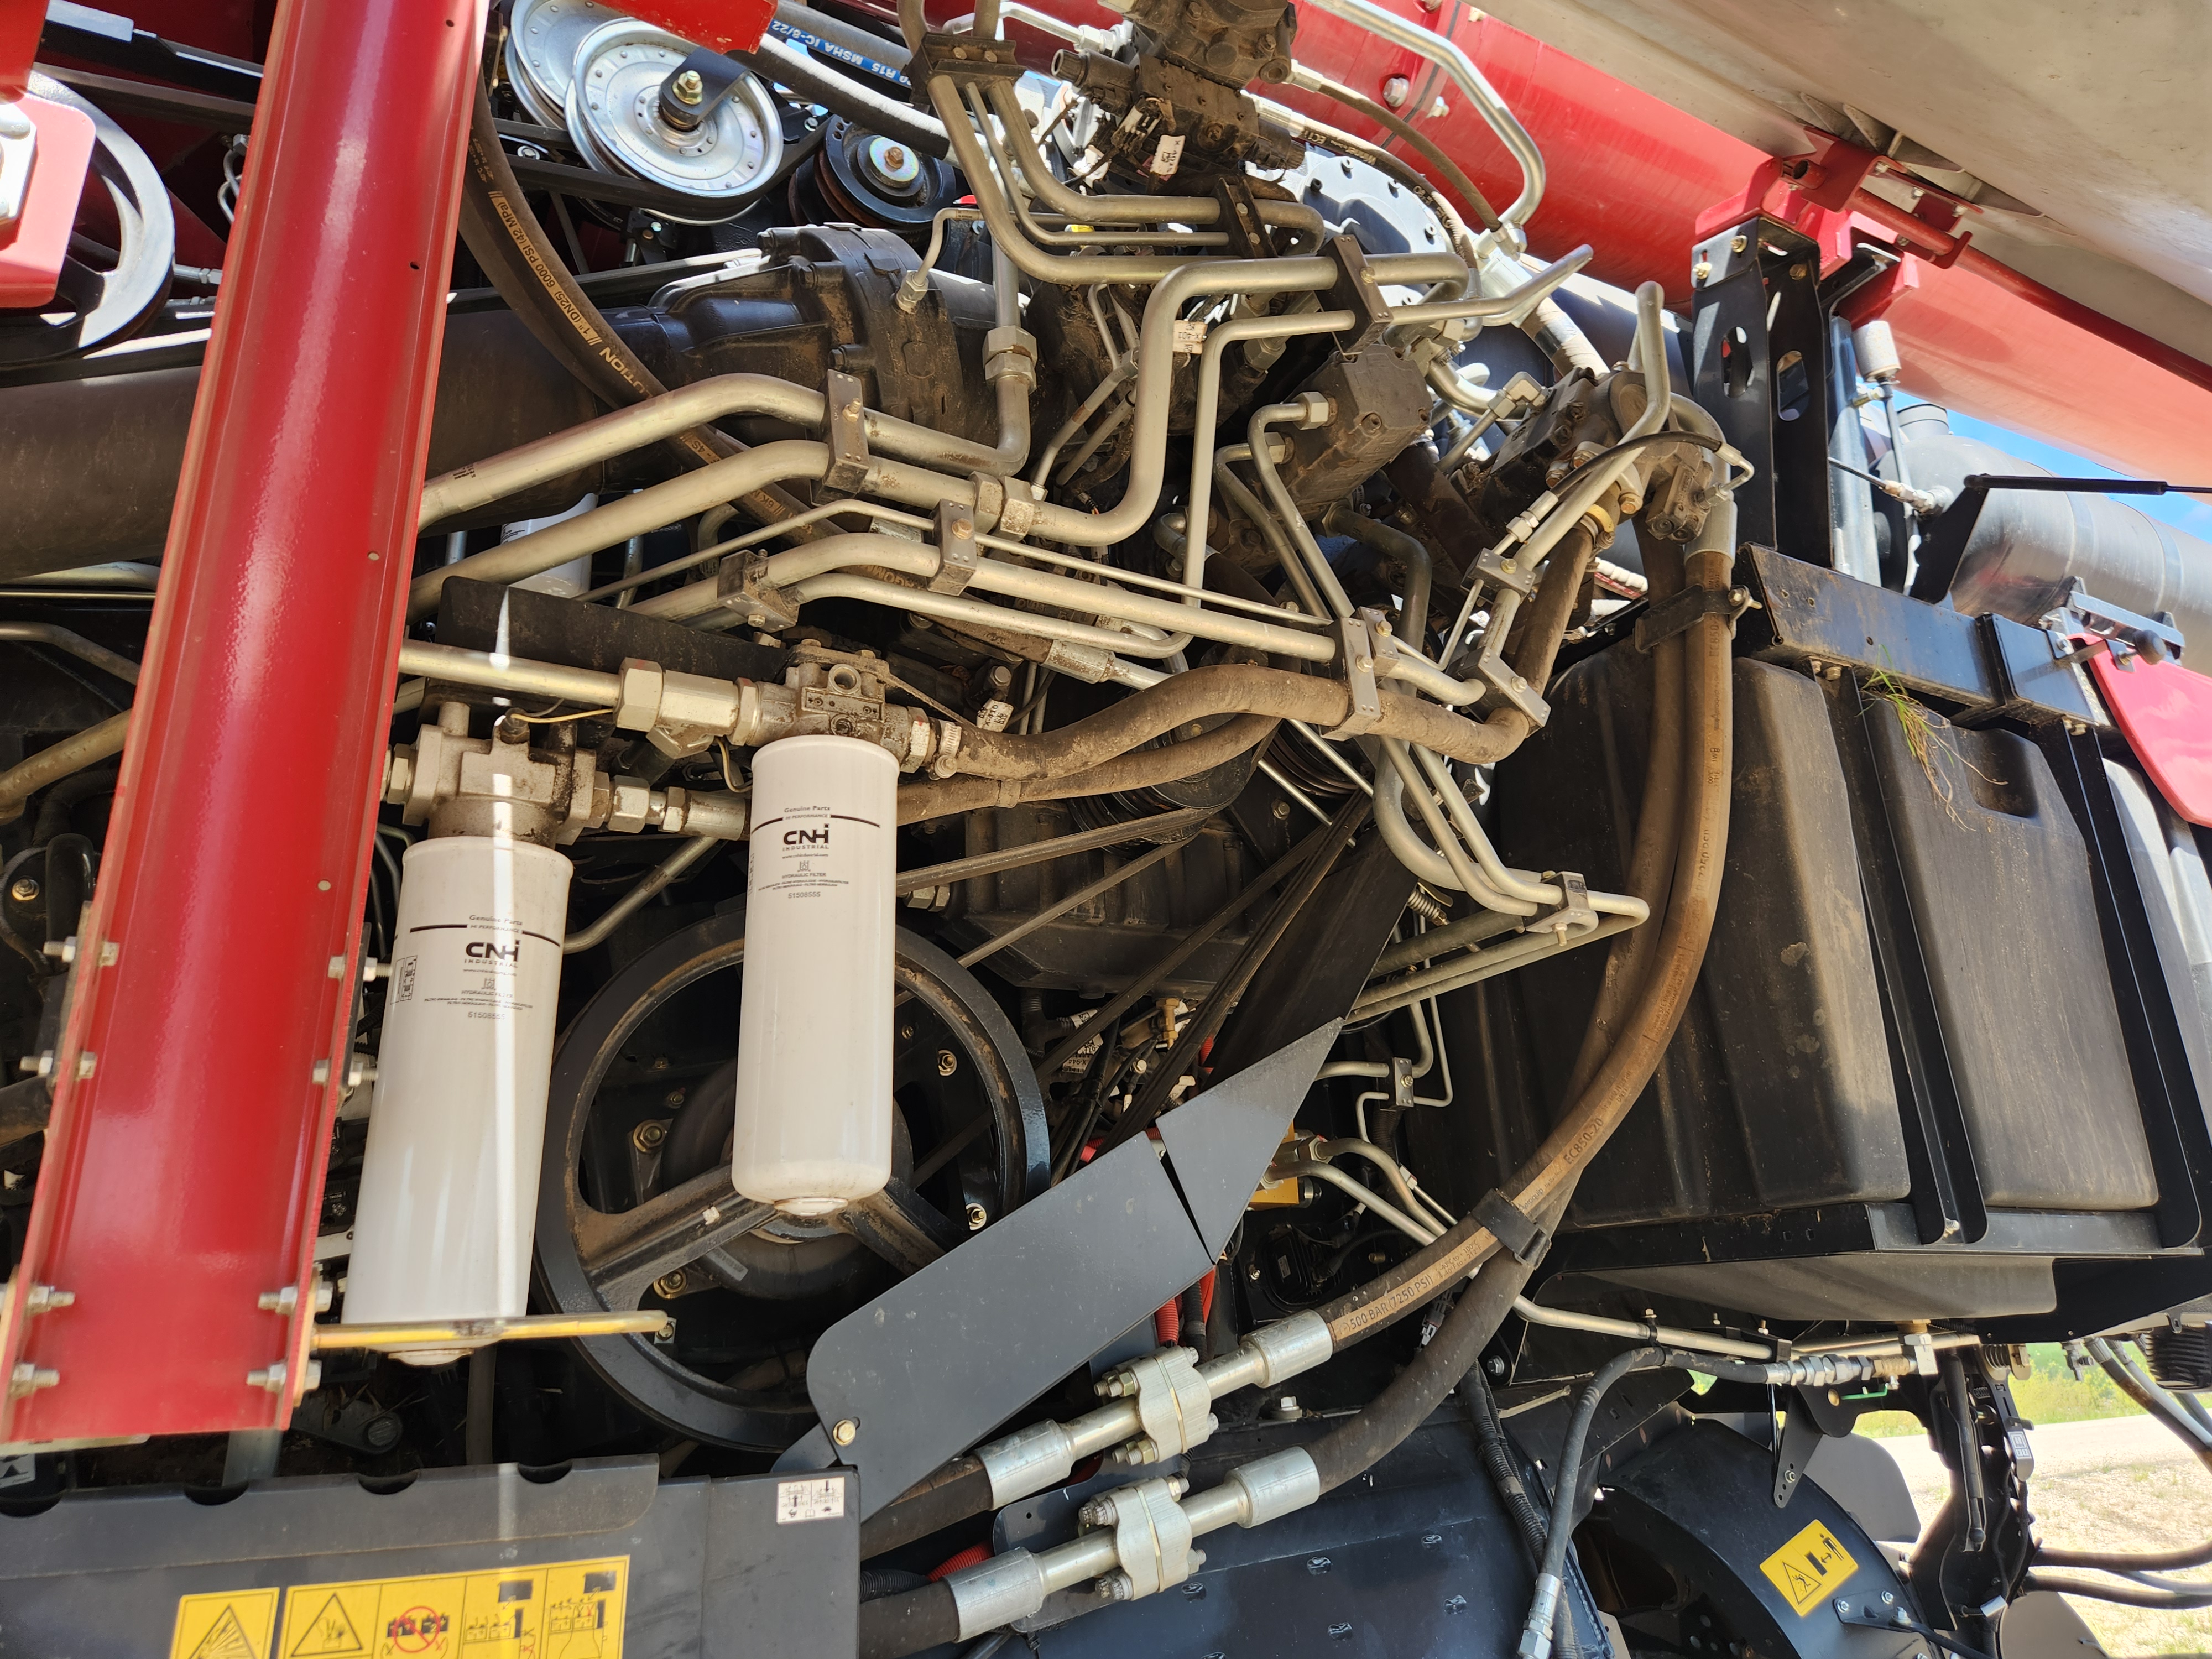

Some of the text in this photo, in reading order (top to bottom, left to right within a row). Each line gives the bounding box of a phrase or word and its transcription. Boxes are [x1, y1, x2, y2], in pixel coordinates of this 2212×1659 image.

[822, 41, 864, 65] MSHA
[870, 61, 896, 79] R15
[1345, 145, 1377, 165] Winner
[496, 200, 517, 228] MPa)
[512, 227, 527, 245] (42
[521, 244, 539, 263] PSI
[534, 262, 556, 288] 6000
[553, 289, 582, 324] (DN25)
[759, 494, 775, 508] 6K
[464, 958, 519, 968] INDUSTRIAL
[467, 1011, 505, 1020] 51508555
[1562, 1115, 1605, 1165] EC850-20
[1367, 1302, 1389, 1320] BAR
[1386, 1285, 1416, 1310] (7250
[1413, 1274, 1434, 1293] PSI)
